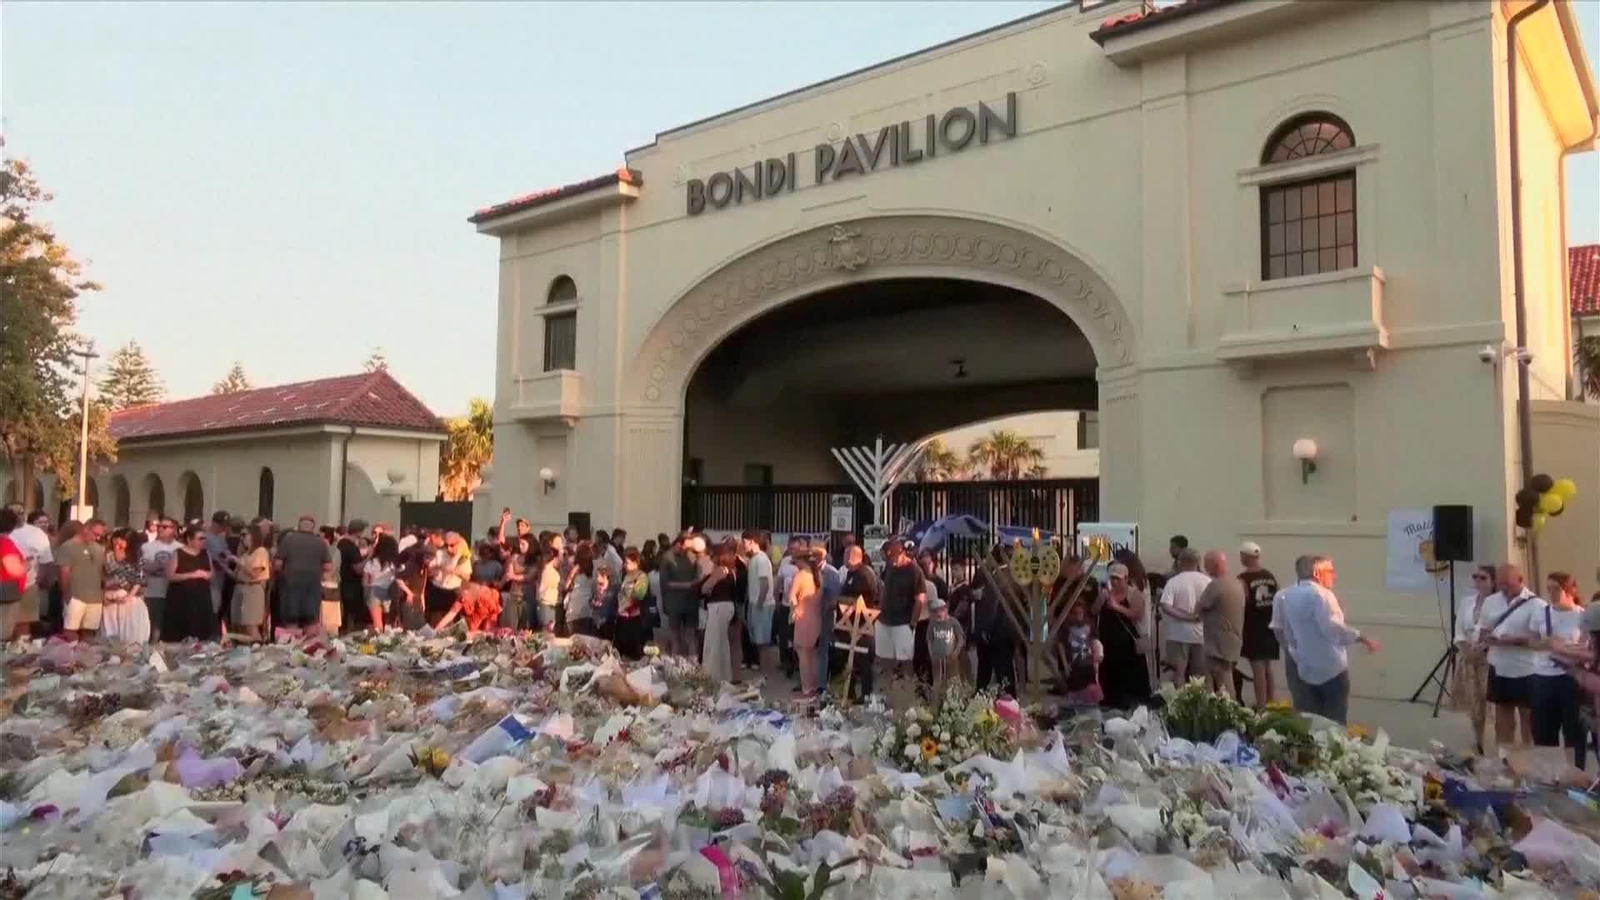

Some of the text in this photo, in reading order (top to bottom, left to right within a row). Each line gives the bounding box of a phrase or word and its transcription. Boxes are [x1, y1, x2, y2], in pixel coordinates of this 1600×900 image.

[686, 91, 1017, 215] BONDI PAVILION
[1081, 540, 1129, 560] BNDI
